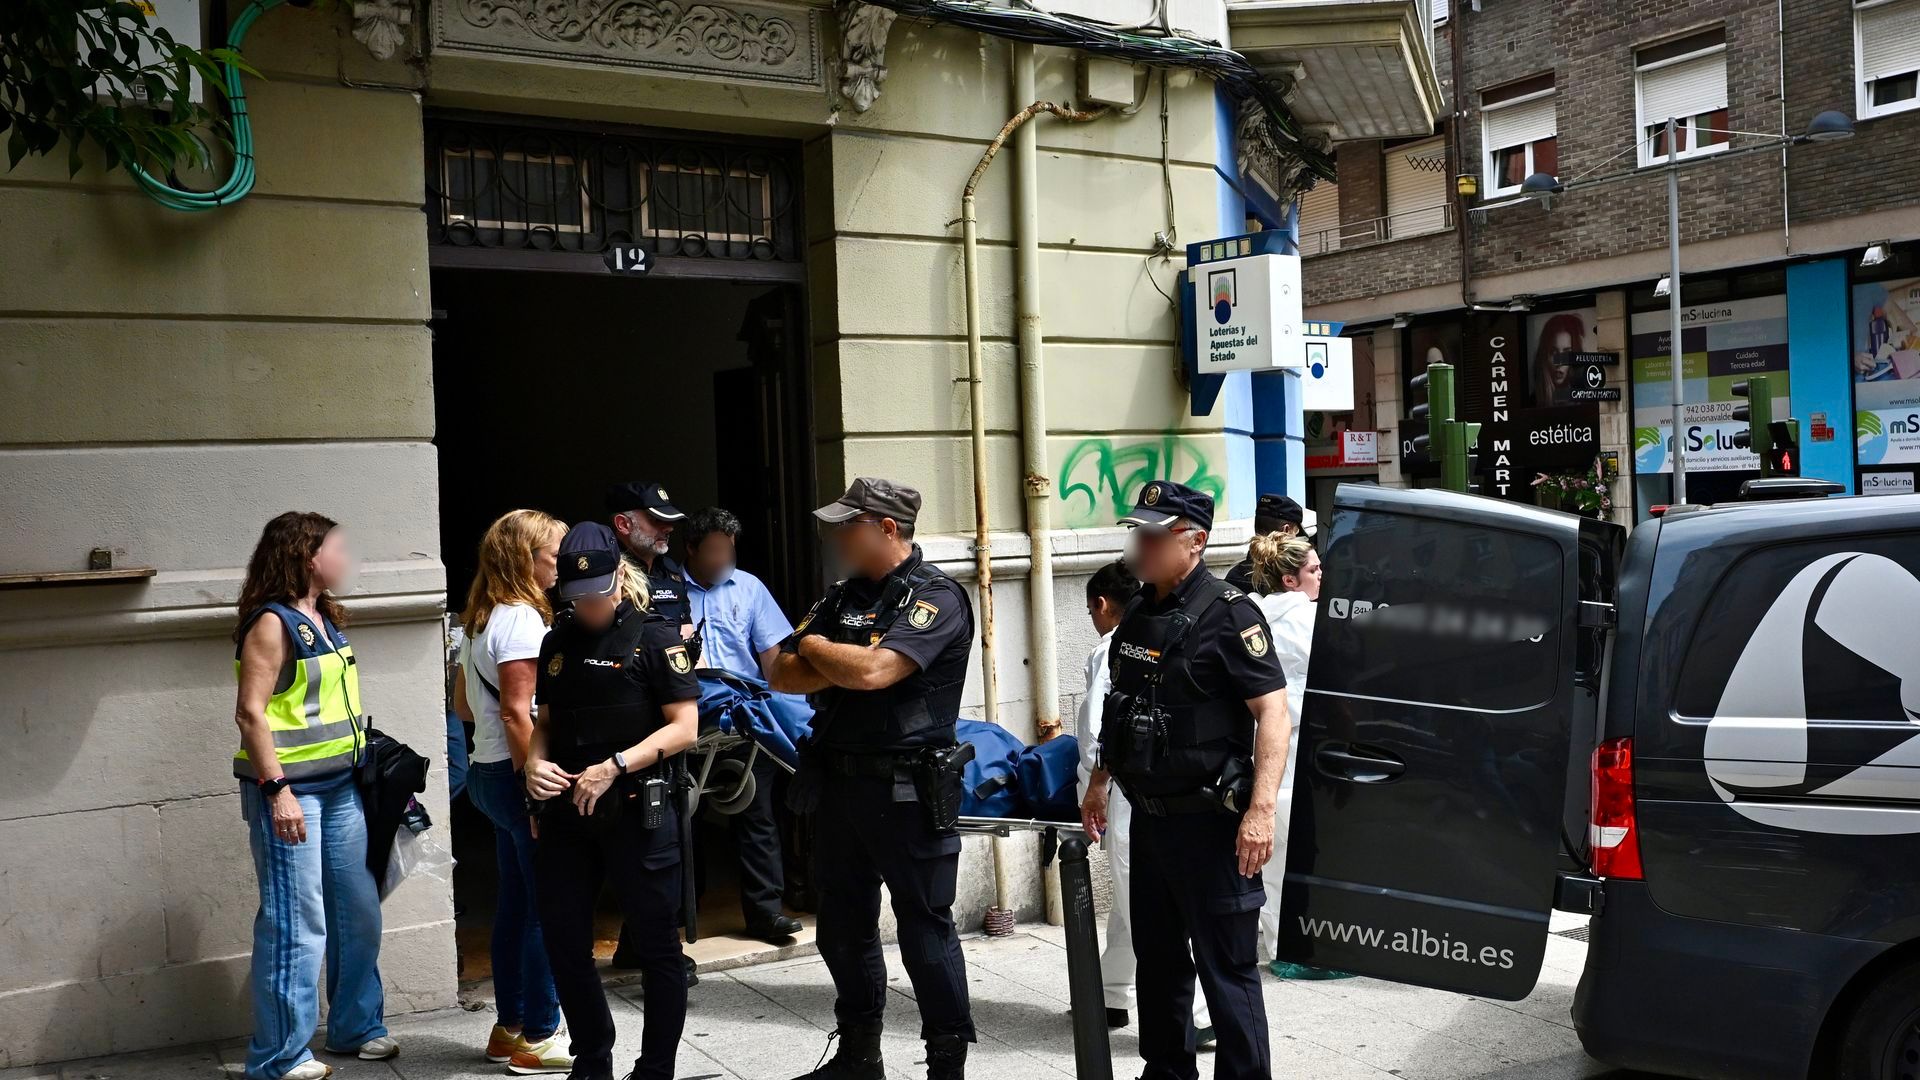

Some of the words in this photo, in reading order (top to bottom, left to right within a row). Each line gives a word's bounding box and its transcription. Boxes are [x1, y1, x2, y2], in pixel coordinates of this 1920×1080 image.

[615, 247, 646, 271] 12
[1209, 324, 1240, 337] Loterías
[1241, 325, 1246, 336] y
[1210, 338, 1245, 352] Apuestas
[1246, 334, 1258, 346] del
[1210, 350, 1236, 362] Estado
[1735, 351, 1759, 360] Cuidado
[1730, 362, 1750, 370] Tercera
[1750, 360, 1766, 368] edad
[1489, 336, 1509, 422] CARMEN
[1571, 390, 1597, 399] CARMEN
[1686, 405, 1699, 413] 942
[1700, 404, 1715, 413] 038
[1716, 403, 1732, 412] 700
[1890, 413, 1920, 434] mS
[1350, 433, 1357, 442] R
[1357, 433, 1365, 442] &
[1365, 433, 1372, 442] T
[1529, 423, 1593, 445] estética
[1493, 439, 1511, 496] MART
[1298, 915, 1515, 970] www.albia.es
